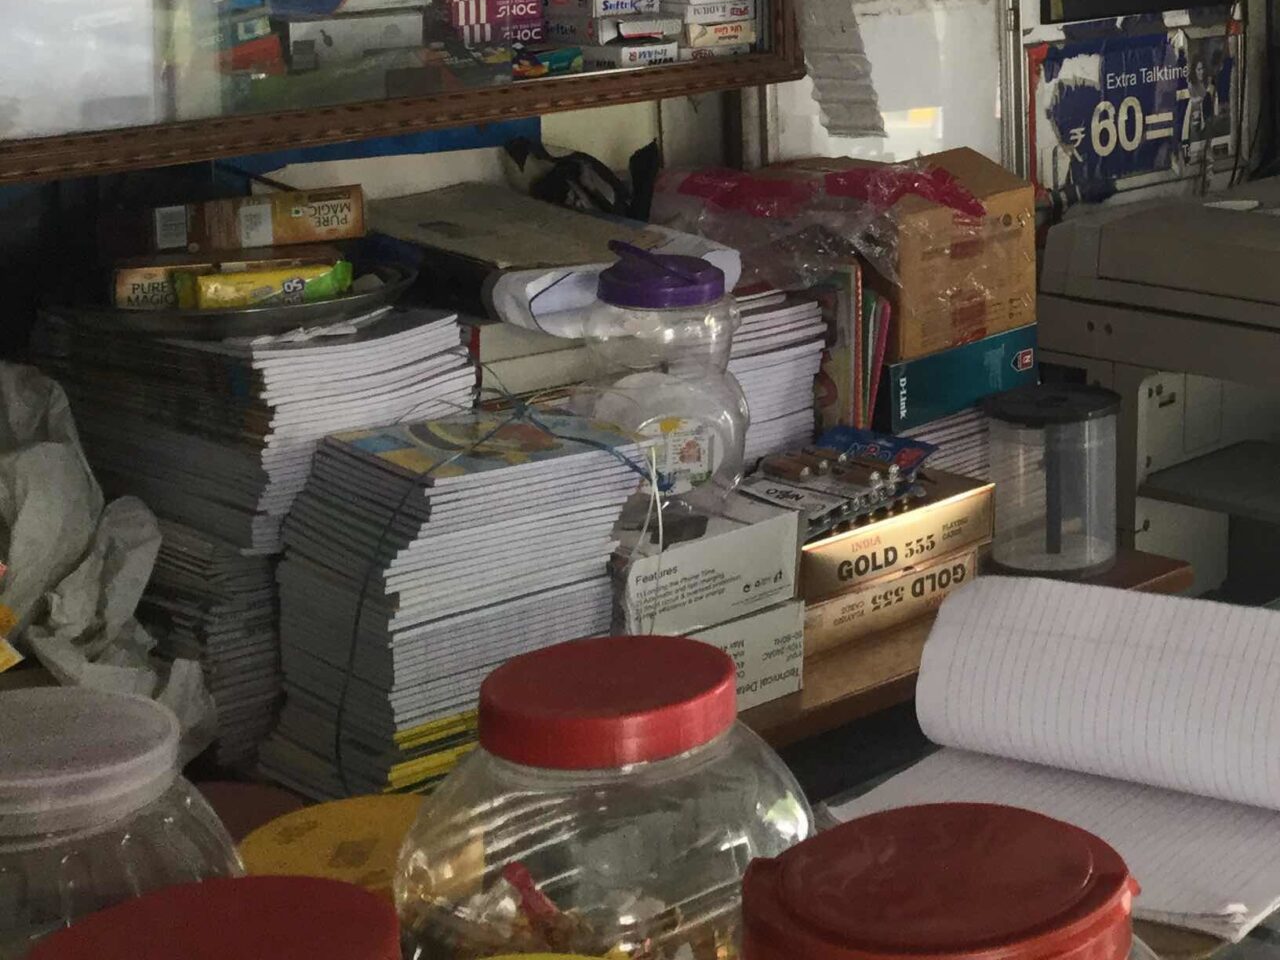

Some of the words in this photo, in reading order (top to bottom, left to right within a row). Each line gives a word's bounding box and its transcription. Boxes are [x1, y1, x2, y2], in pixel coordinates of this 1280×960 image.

[1106, 71, 1137, 90] Extra
[1139, 65, 1190, 83] Talktime
[309, 203, 351, 218] MAGIC
[316, 215, 348, 228] PURE
[132, 282, 168, 296] PURE
[899, 376, 908, 420] D-Link
[850, 535, 881, 553] INDIA
[837, 546, 898, 582] GOLD
[904, 534, 936, 559] 555
[635, 566, 678, 585] Features
[911, 563, 967, 598] GOLD
